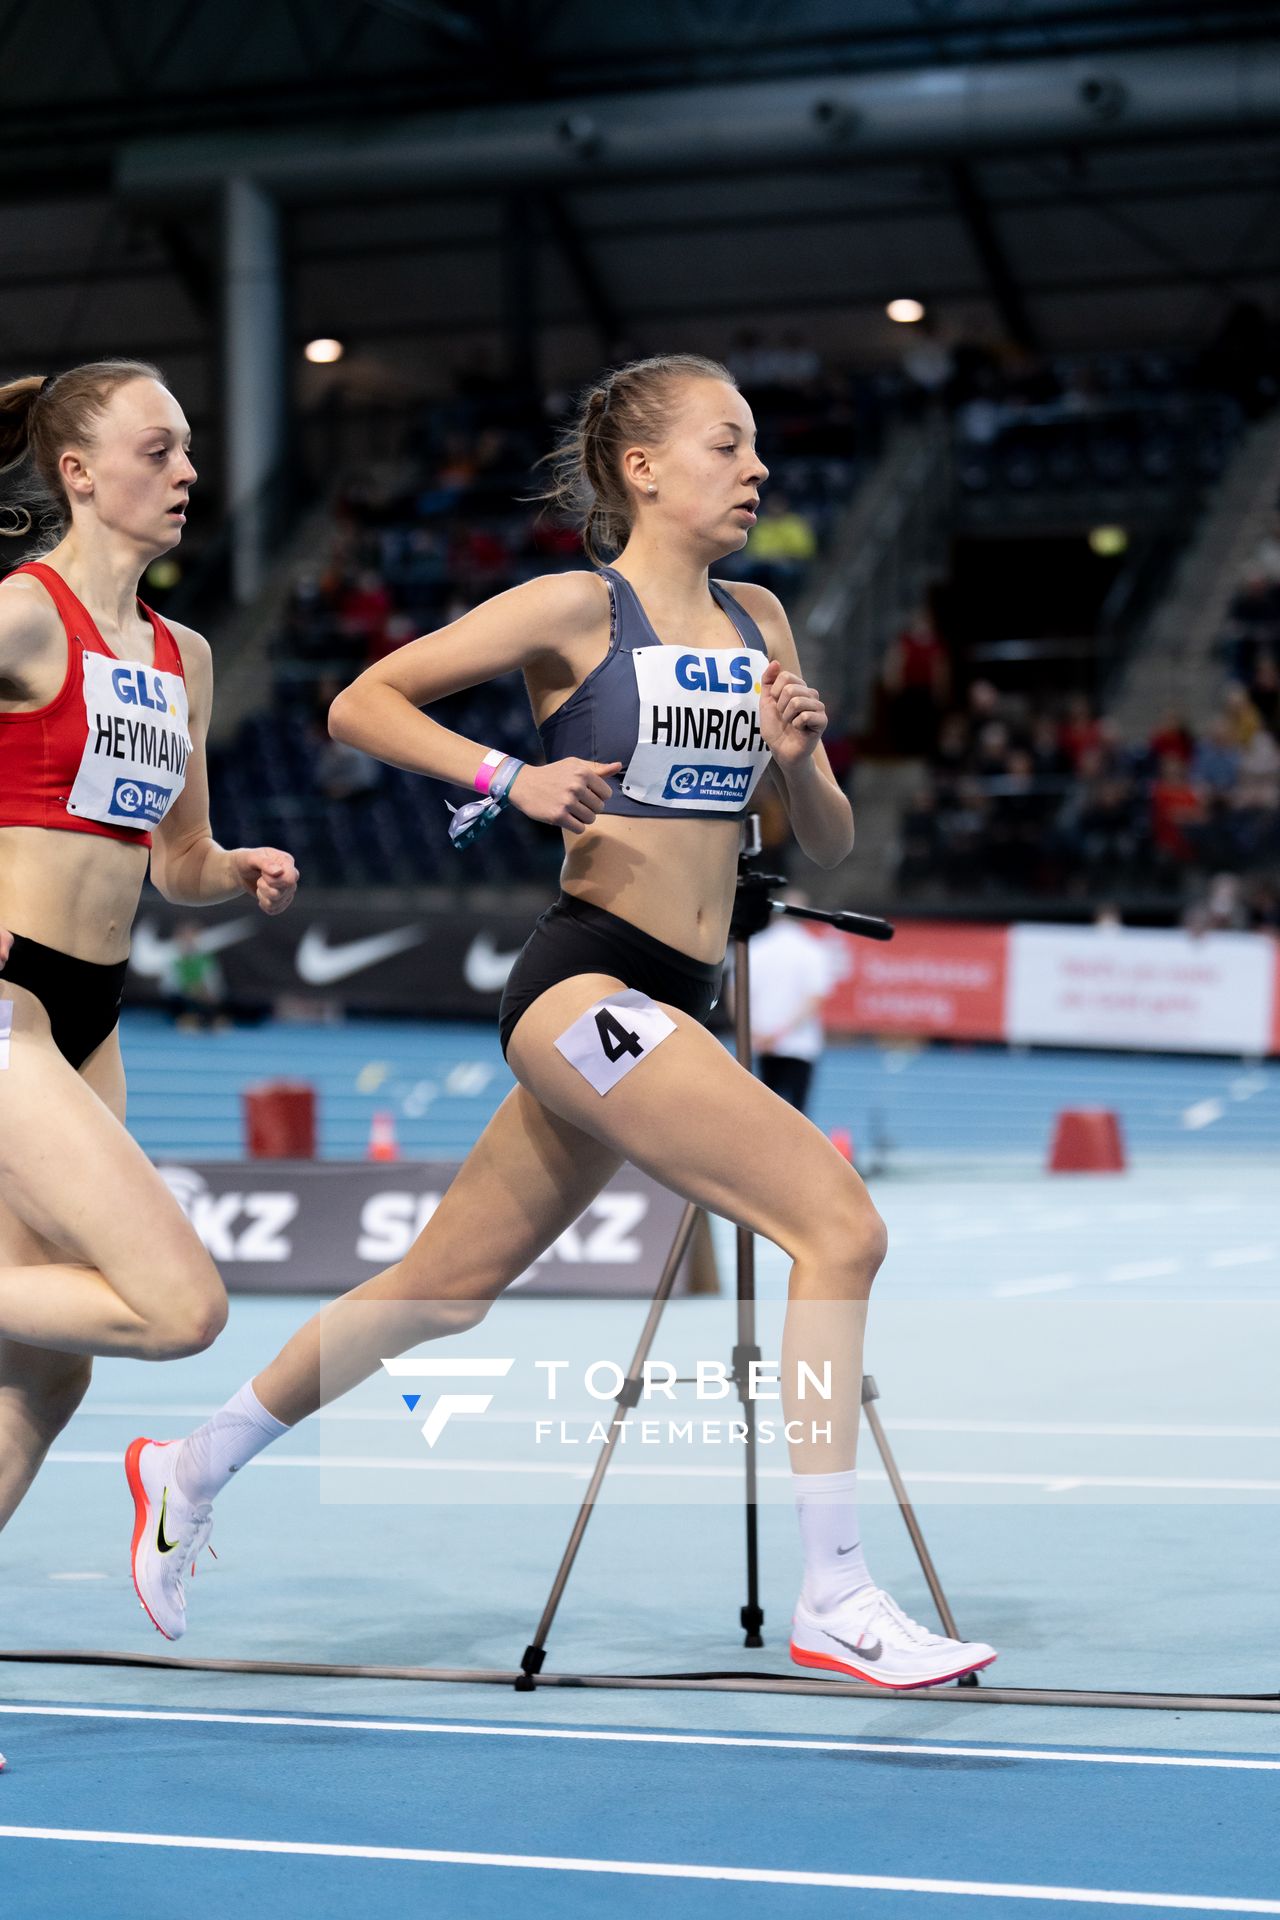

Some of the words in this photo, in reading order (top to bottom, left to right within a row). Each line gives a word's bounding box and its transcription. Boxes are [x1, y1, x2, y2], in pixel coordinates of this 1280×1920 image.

[651, 705, 770, 752] HINRICH
[699, 788, 744, 798] INTERNATIONAL
[700, 771, 749, 790] PLAN
[144, 789, 169, 814] PLAN
[594, 1007, 644, 1063] 4
